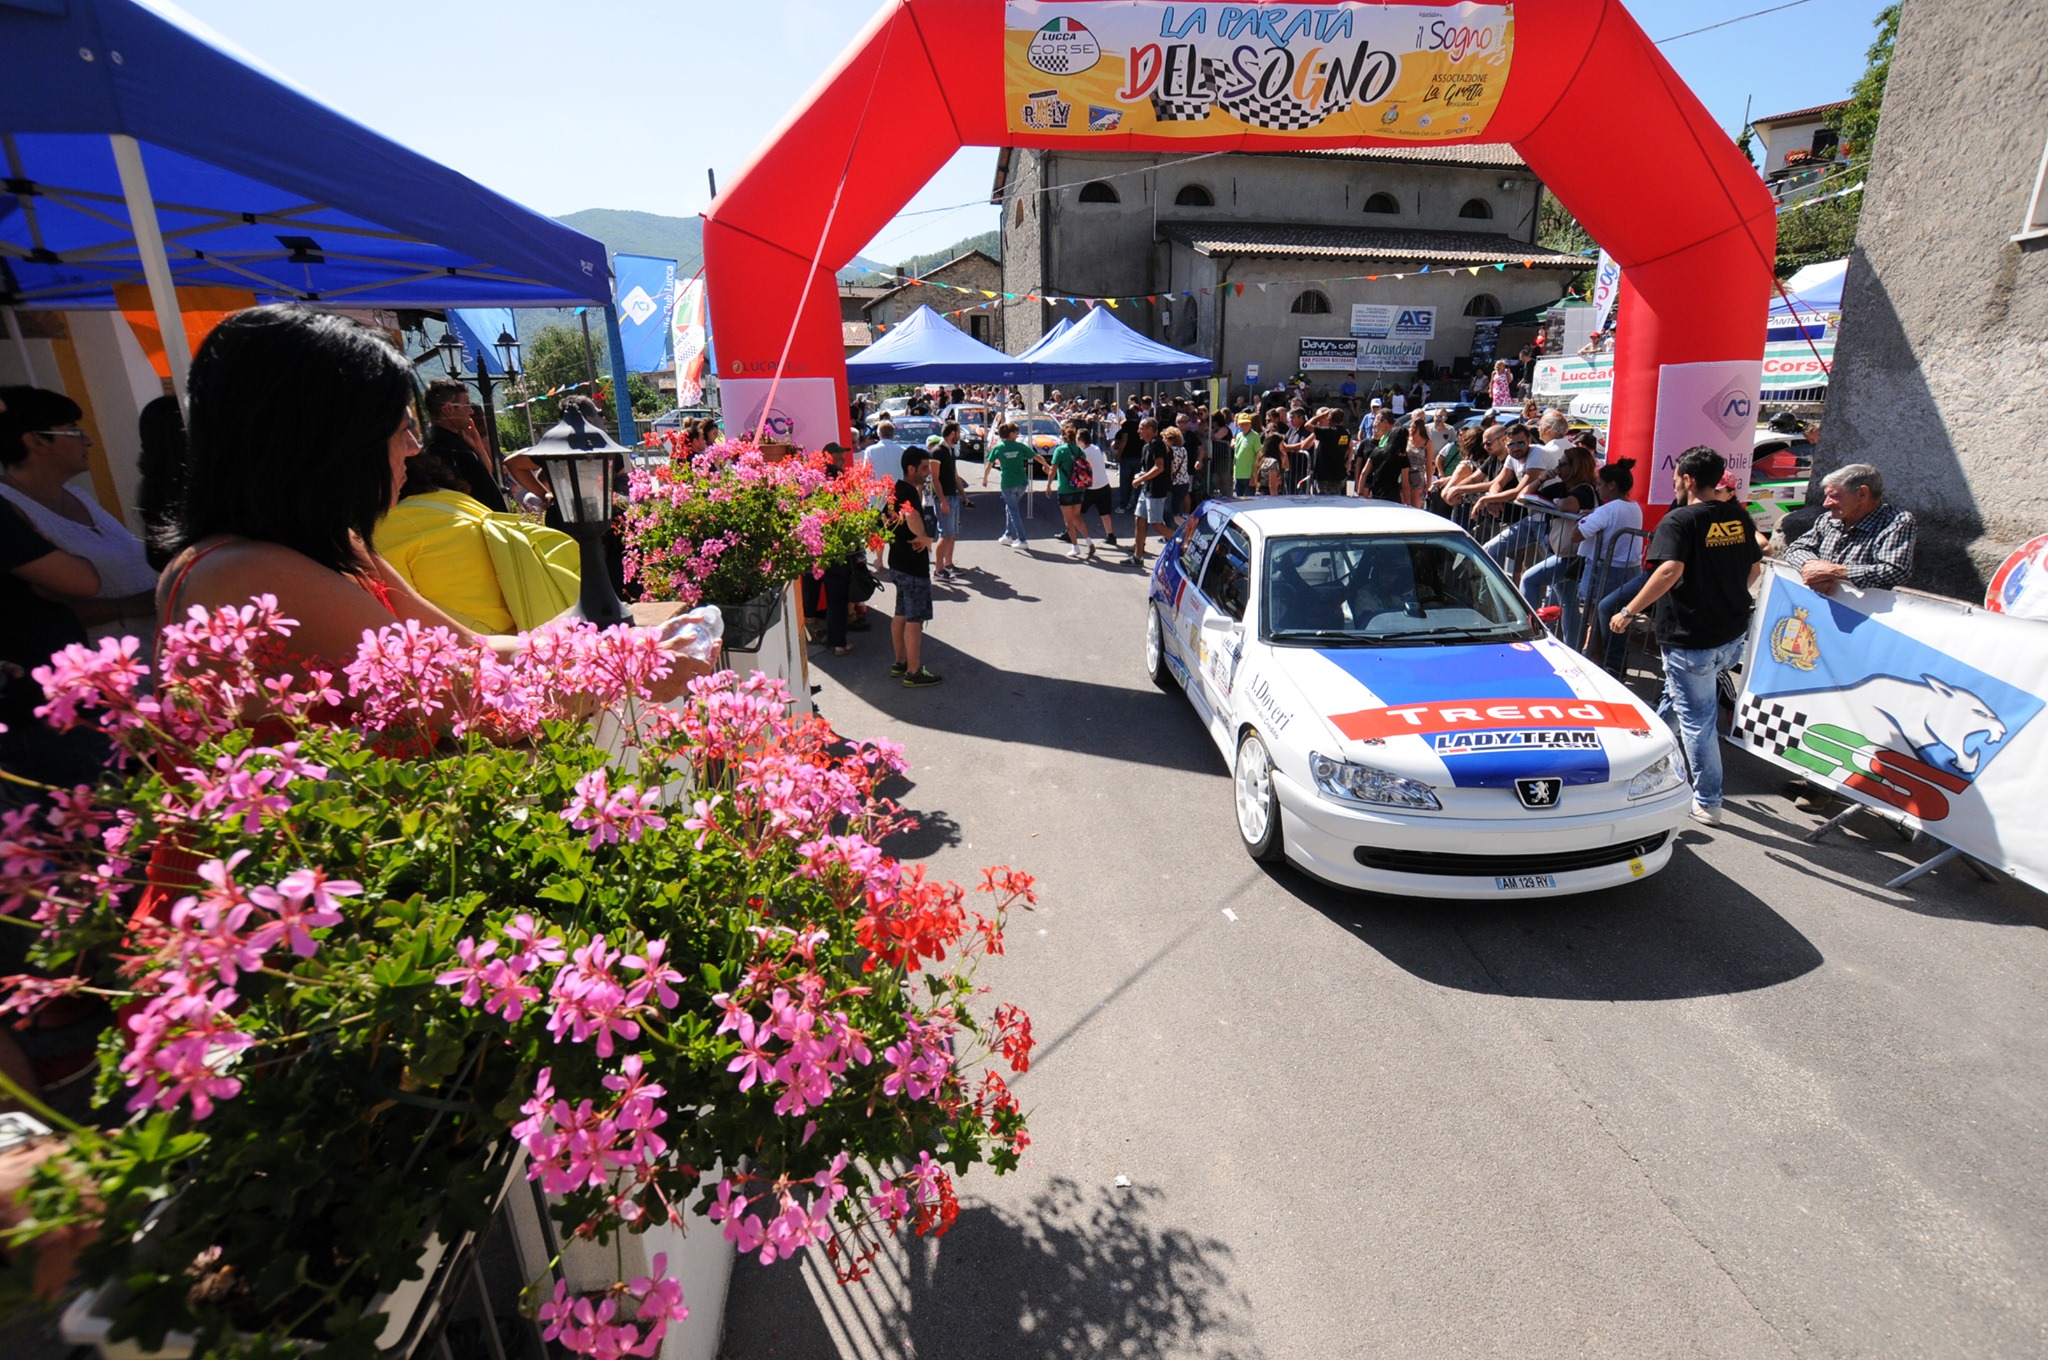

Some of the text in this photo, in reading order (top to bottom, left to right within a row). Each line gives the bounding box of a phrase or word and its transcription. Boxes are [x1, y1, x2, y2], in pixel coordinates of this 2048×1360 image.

[1160, 6, 1353, 48] LA PARATA
[1042, 33, 1076, 41] LUCCA
[1416, 20, 1493, 62] il Sogno
[1030, 44, 1095, 54] CORSE
[1120, 40, 1397, 110] DEL SOGNO
[1431, 74, 1488, 82] ASSOCIAZIONE
[1424, 83, 1484, 106] La Grotta
[632, 300, 650, 311] ACI
[1398, 311, 1432, 325] AG
[1302, 340, 1337, 350] Davy's
[1366, 342, 1422, 355] Lavanderia
[743, 361, 792, 371] LUCAT
[1561, 369, 1606, 381] Lucca
[1723, 399, 1750, 416] ACI
[1706, 520, 1744, 538] AG
[1438, 732, 1596, 748] LADY TEAM
[1502, 876, 1549, 889] AM 129 RY
